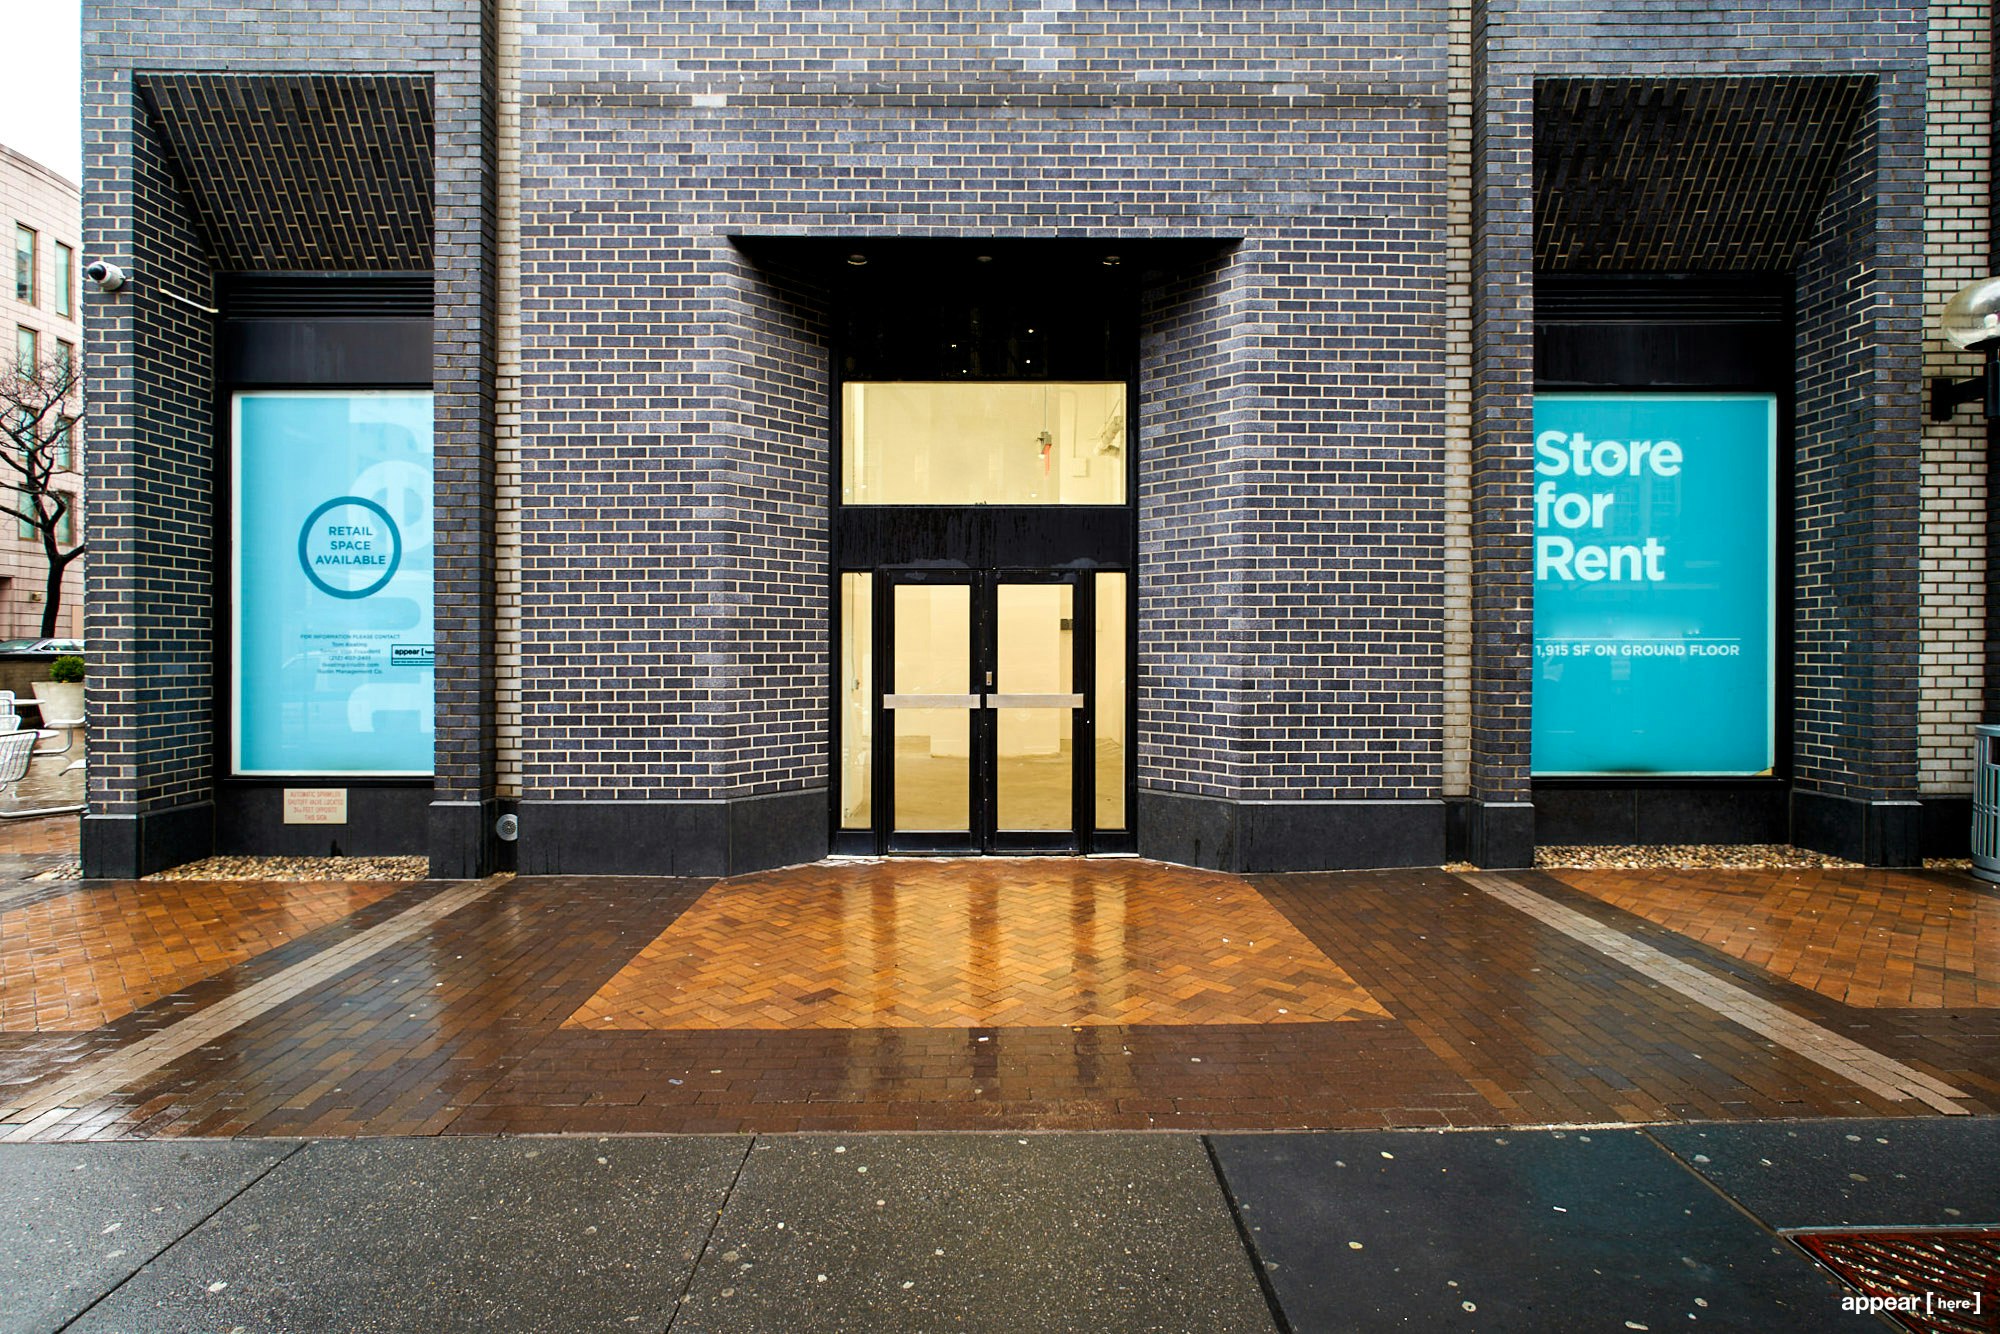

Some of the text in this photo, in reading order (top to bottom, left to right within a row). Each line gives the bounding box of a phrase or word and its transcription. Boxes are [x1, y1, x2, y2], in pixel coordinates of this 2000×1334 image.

[1535, 430, 1683, 477] Store
[1534, 481, 1614, 528] for
[328, 526, 373, 536] RETAIL
[330, 541, 371, 550] SPACE
[315, 555, 387, 565] AVAILABLE
[1537, 535, 1666, 581] Rent
[1535, 645, 1740, 658] 1,915 SF ON GROUND FLOOR
